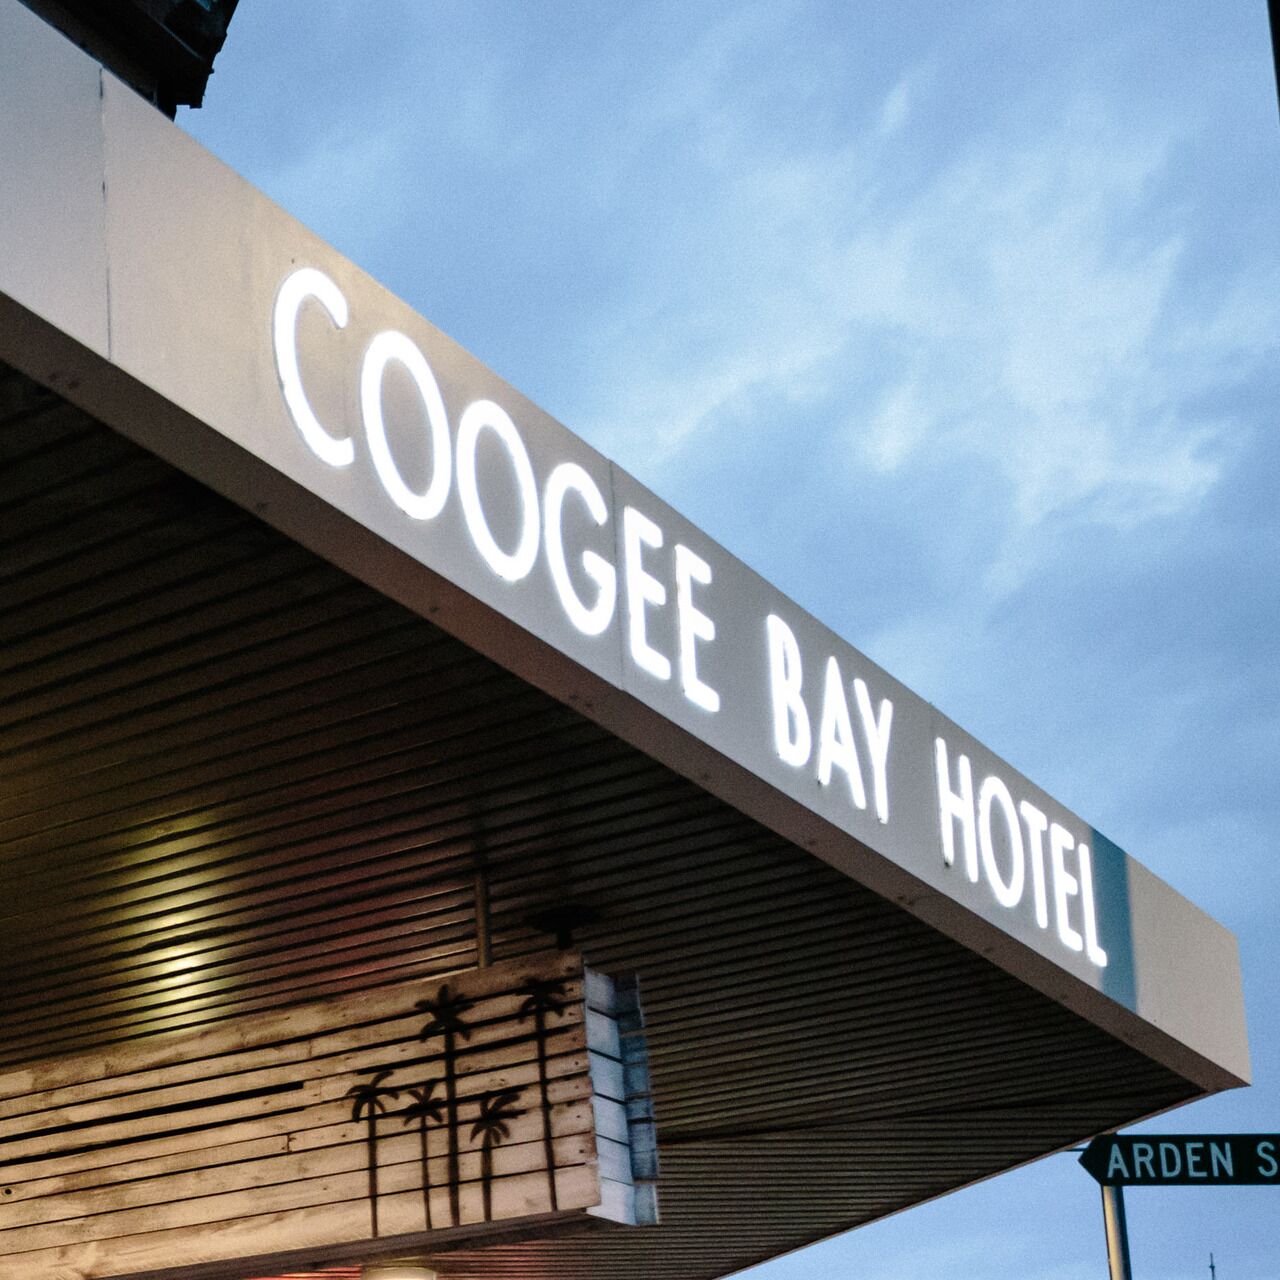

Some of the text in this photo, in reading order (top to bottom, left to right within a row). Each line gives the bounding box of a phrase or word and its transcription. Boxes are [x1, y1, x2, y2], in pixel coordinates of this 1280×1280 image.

[273, 267, 1108, 968] COOGEE BAY HOTEL
[1107, 1141, 1280, 1178] ARDEN S
